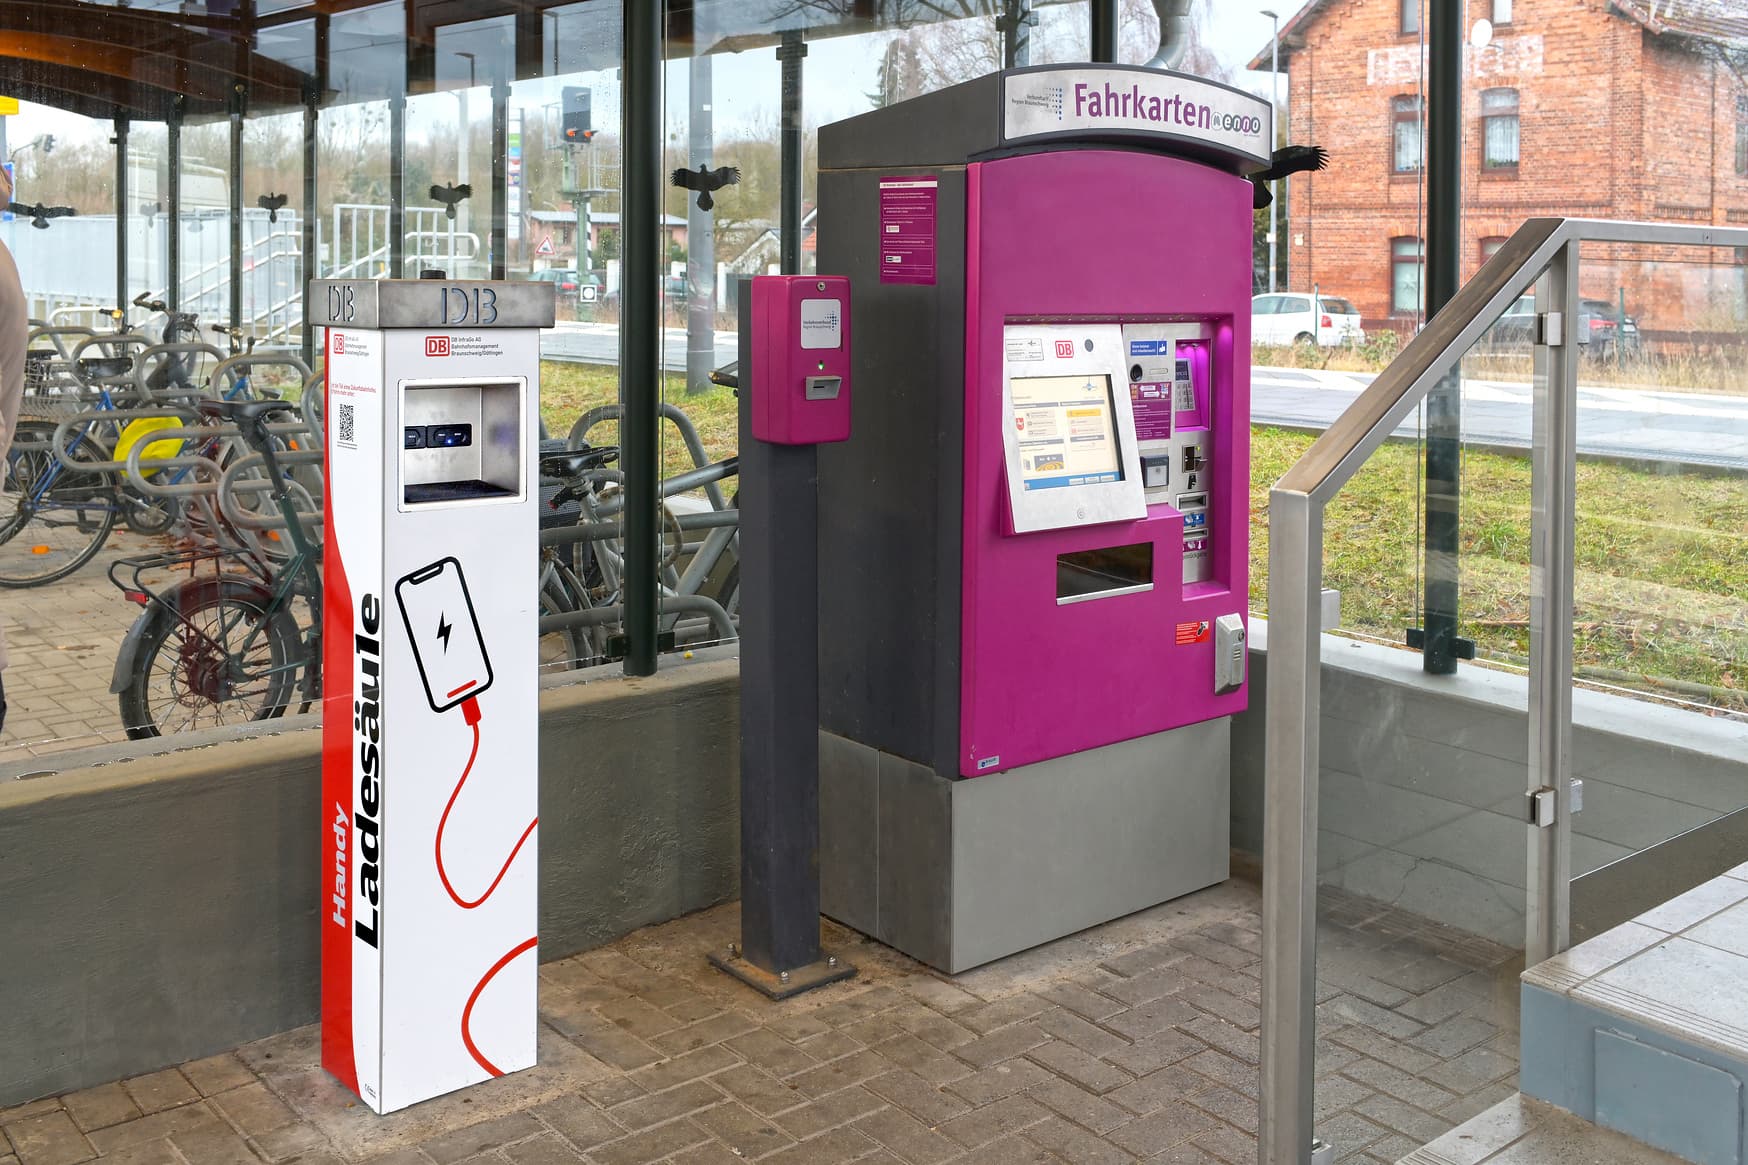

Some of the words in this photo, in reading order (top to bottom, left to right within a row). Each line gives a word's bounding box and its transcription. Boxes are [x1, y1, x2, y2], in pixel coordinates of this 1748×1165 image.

[1074, 83, 1210, 129] Fahrkarten
[328, 285, 356, 322] DB
[441, 287, 498, 325] DB
[428, 339, 448, 354] DB
[1056, 343, 1072, 356] DB
[355, 593, 380, 950] Ladesäule
[333, 801, 350, 928] Handy
